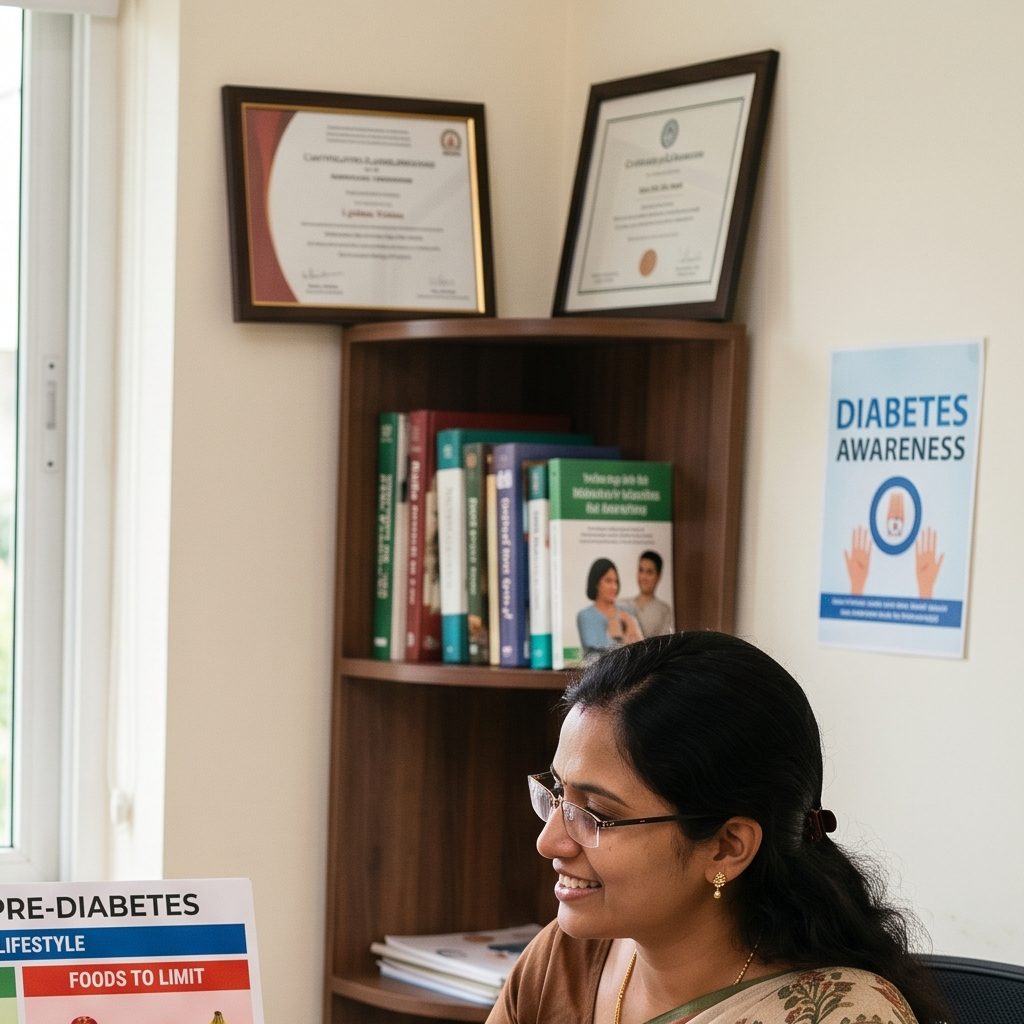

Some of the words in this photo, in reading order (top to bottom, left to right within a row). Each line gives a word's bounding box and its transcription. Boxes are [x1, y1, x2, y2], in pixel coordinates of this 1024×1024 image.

[837, 395, 968, 429] DIABETES
[836, 436, 966, 462] AWARENESS
[69, 970, 127, 989] FOODS
[130, 969, 154, 987] TO
[158, 967, 205, 986] LIMIT
